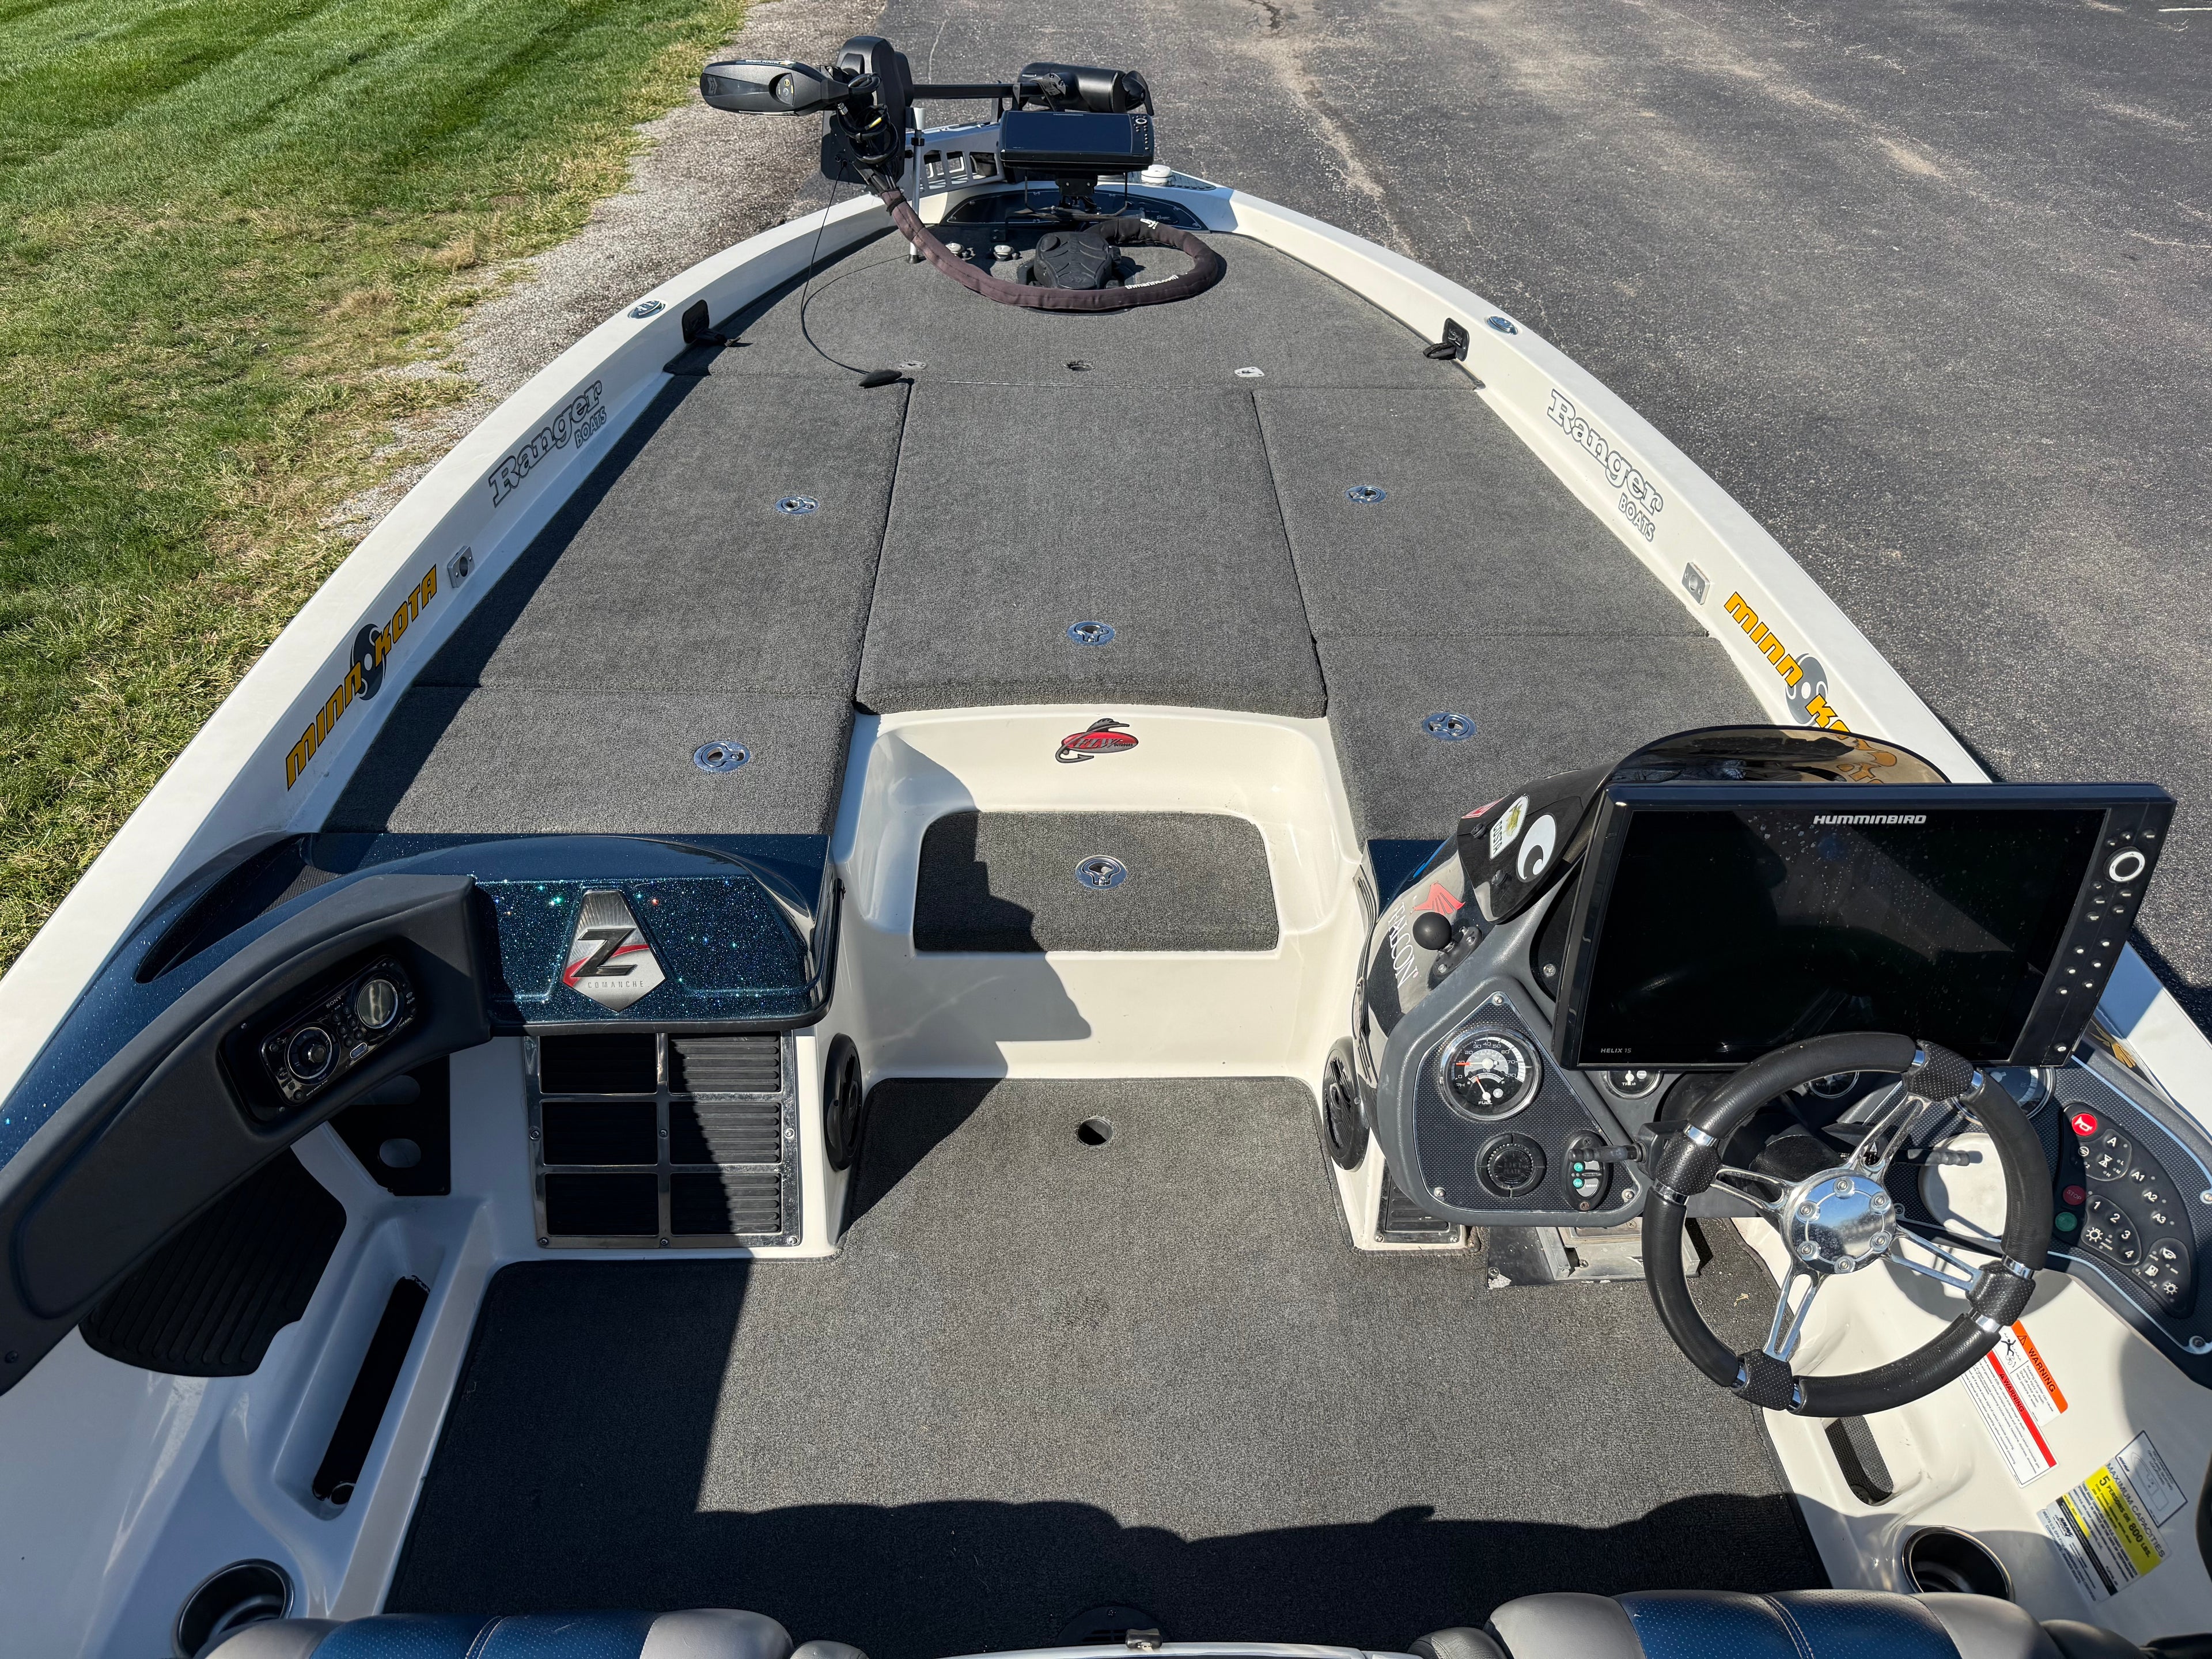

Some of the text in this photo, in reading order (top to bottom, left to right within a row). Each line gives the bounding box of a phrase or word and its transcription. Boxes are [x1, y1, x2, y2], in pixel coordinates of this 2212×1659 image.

[574, 406, 607, 449] BOATS
[488, 380, 603, 508] Ranger
[1547, 389, 1664, 516] Ranger
[1618, 491, 1656, 543] BOATS
[1073, 738, 1121, 748] FLW
[1813, 815, 1927, 824] HUMMINBIRD
[1493, 820, 1503, 854] COSTA
[1388, 902, 1418, 988] FALCON
[570, 927, 638, 978] Z
[588, 980, 644, 988] COMANCHE
[325, 995, 342, 1009] SONY
[2107, 1137, 2116, 1147] A
[2131, 1171, 2145, 1181] A1
[2066, 1189, 2082, 1200] STOP
[2143, 1191, 2158, 1203] A2
[2094, 1201, 2101, 1210] 1
[2110, 1213, 2120, 1223] 2
[2152, 1213, 2166, 1224] A3
[2121, 1230, 2131, 1240] 3
[2125, 1251, 2134, 1259] 4
[2028, 1347, 2056, 1393] WARNING
[2003, 1378, 2025, 1413] WARNING
[2099, 1475, 2111, 1486] 5
[2106, 1485, 2126, 1513] PERSONS
[2127, 1522, 2145, 1543] 800
[2105, 1463, 2134, 1505] MAXIMUM
[2131, 1505, 2166, 1558] CAPACITIES
